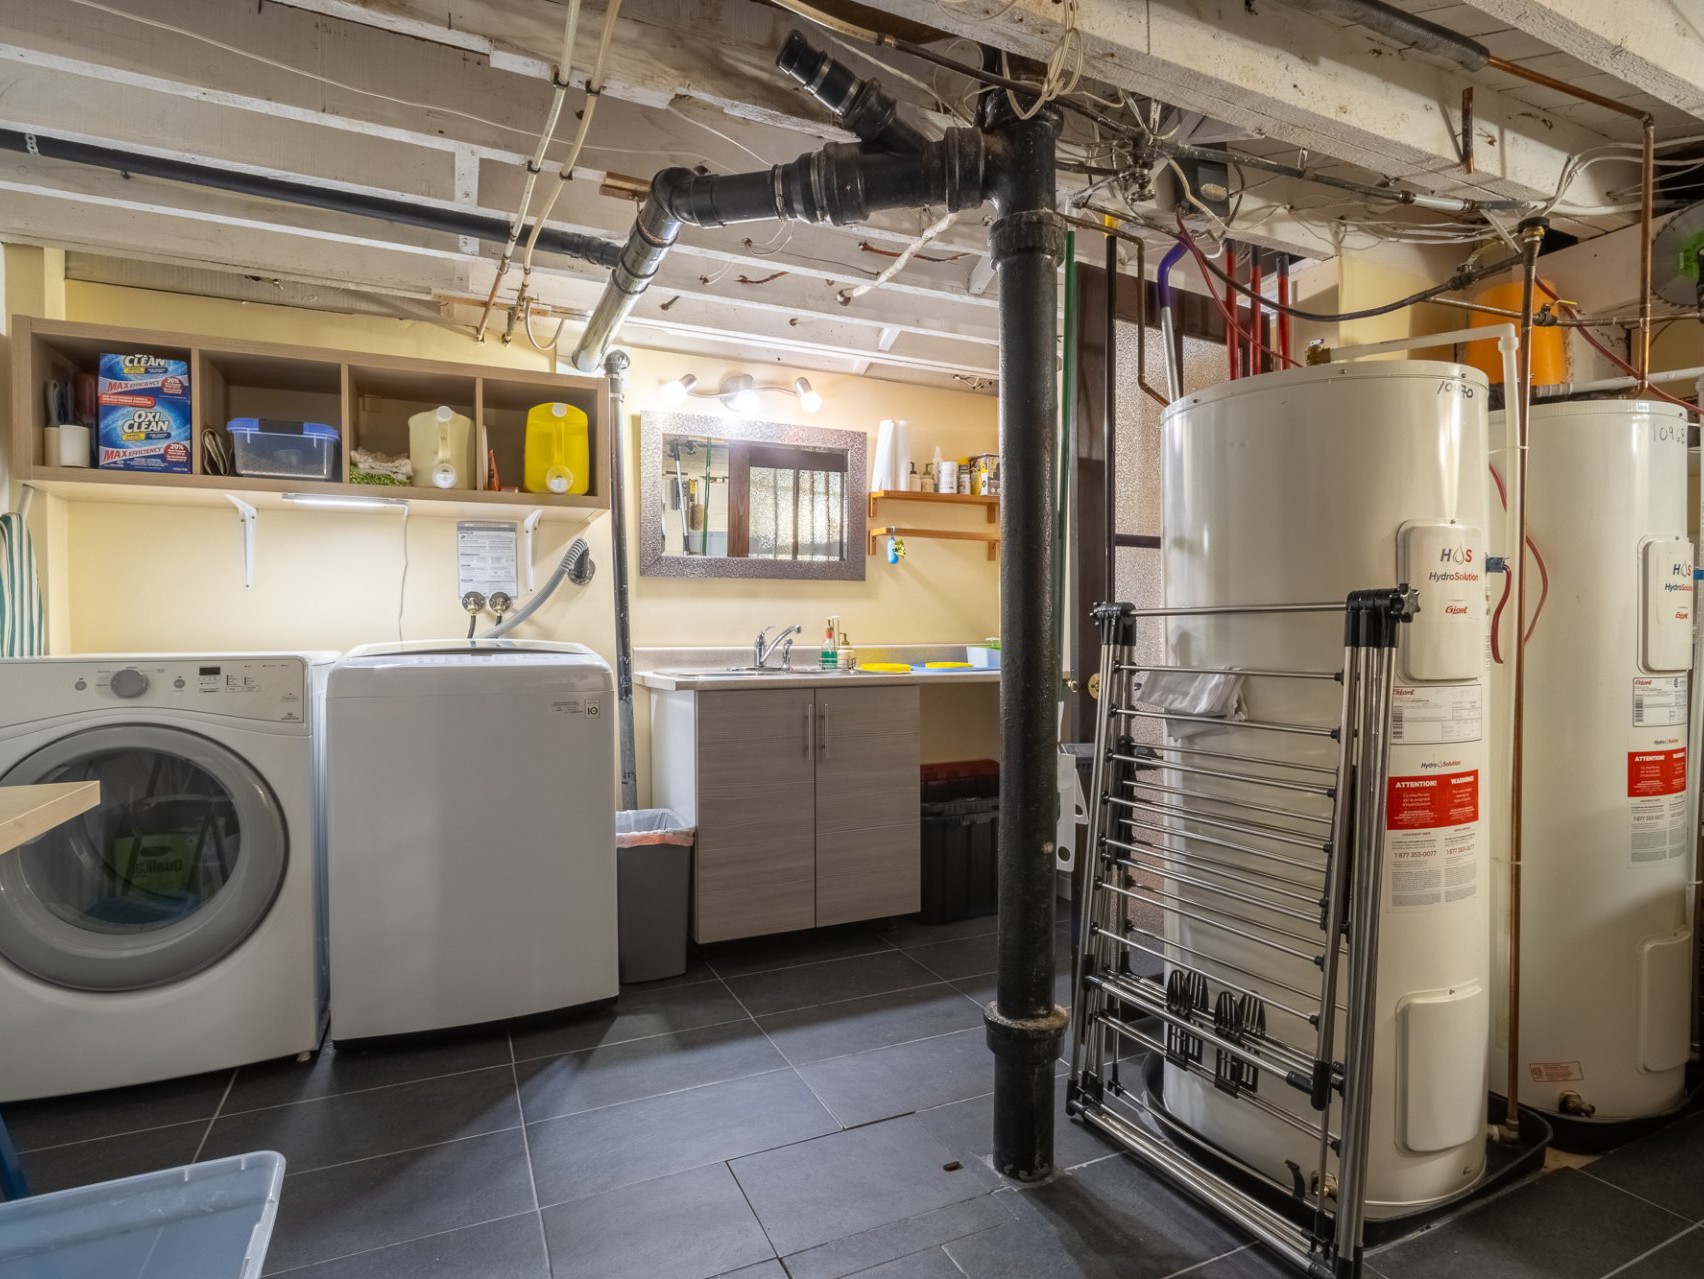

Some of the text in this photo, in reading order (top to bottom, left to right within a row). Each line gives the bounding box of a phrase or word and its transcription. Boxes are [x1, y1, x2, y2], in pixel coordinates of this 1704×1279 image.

[124, 355, 166, 367] CLEAN
[107, 381, 130, 392] MAX
[1437, 380, 1475, 400] 1070
[133, 410, 162, 422] OXI
[122, 420, 169, 433] CLEAN
[103, 449, 128, 462] MAX
[128, 447, 163, 457] EFFICIENCY
[1428, 571, 1479, 582] HydroSolution
[1395, 780, 1437, 789] ATTENTION!
[1398, 851, 1410, 859] 877
[1410, 850, 1437, 858] 353-0077
